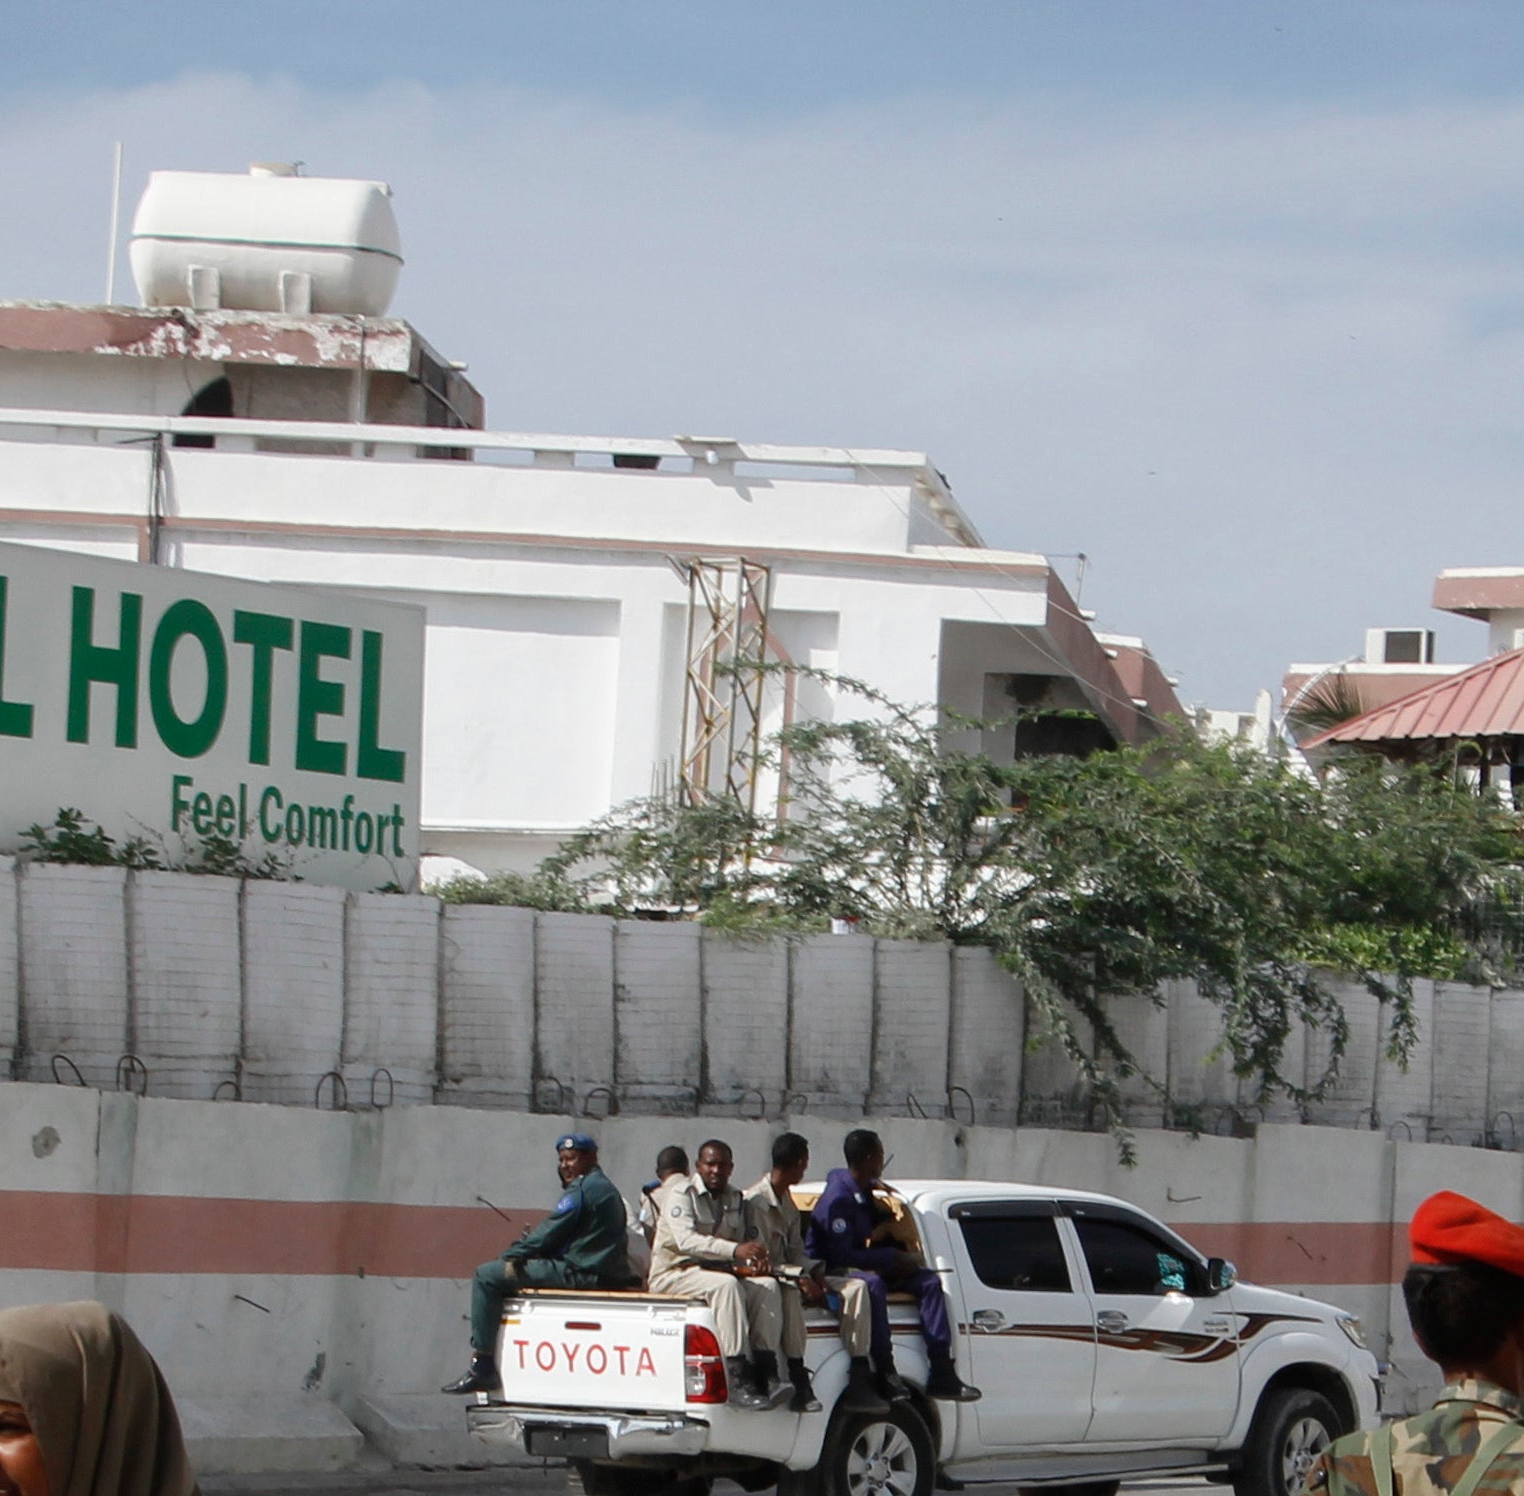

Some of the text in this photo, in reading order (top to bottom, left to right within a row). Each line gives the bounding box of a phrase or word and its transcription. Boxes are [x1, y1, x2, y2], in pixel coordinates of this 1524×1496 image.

[67, 585, 406, 783] HOTEL
[172, 775, 405, 858] Feel Comfort
[513, 1340, 657, 1377] TOYOTA
